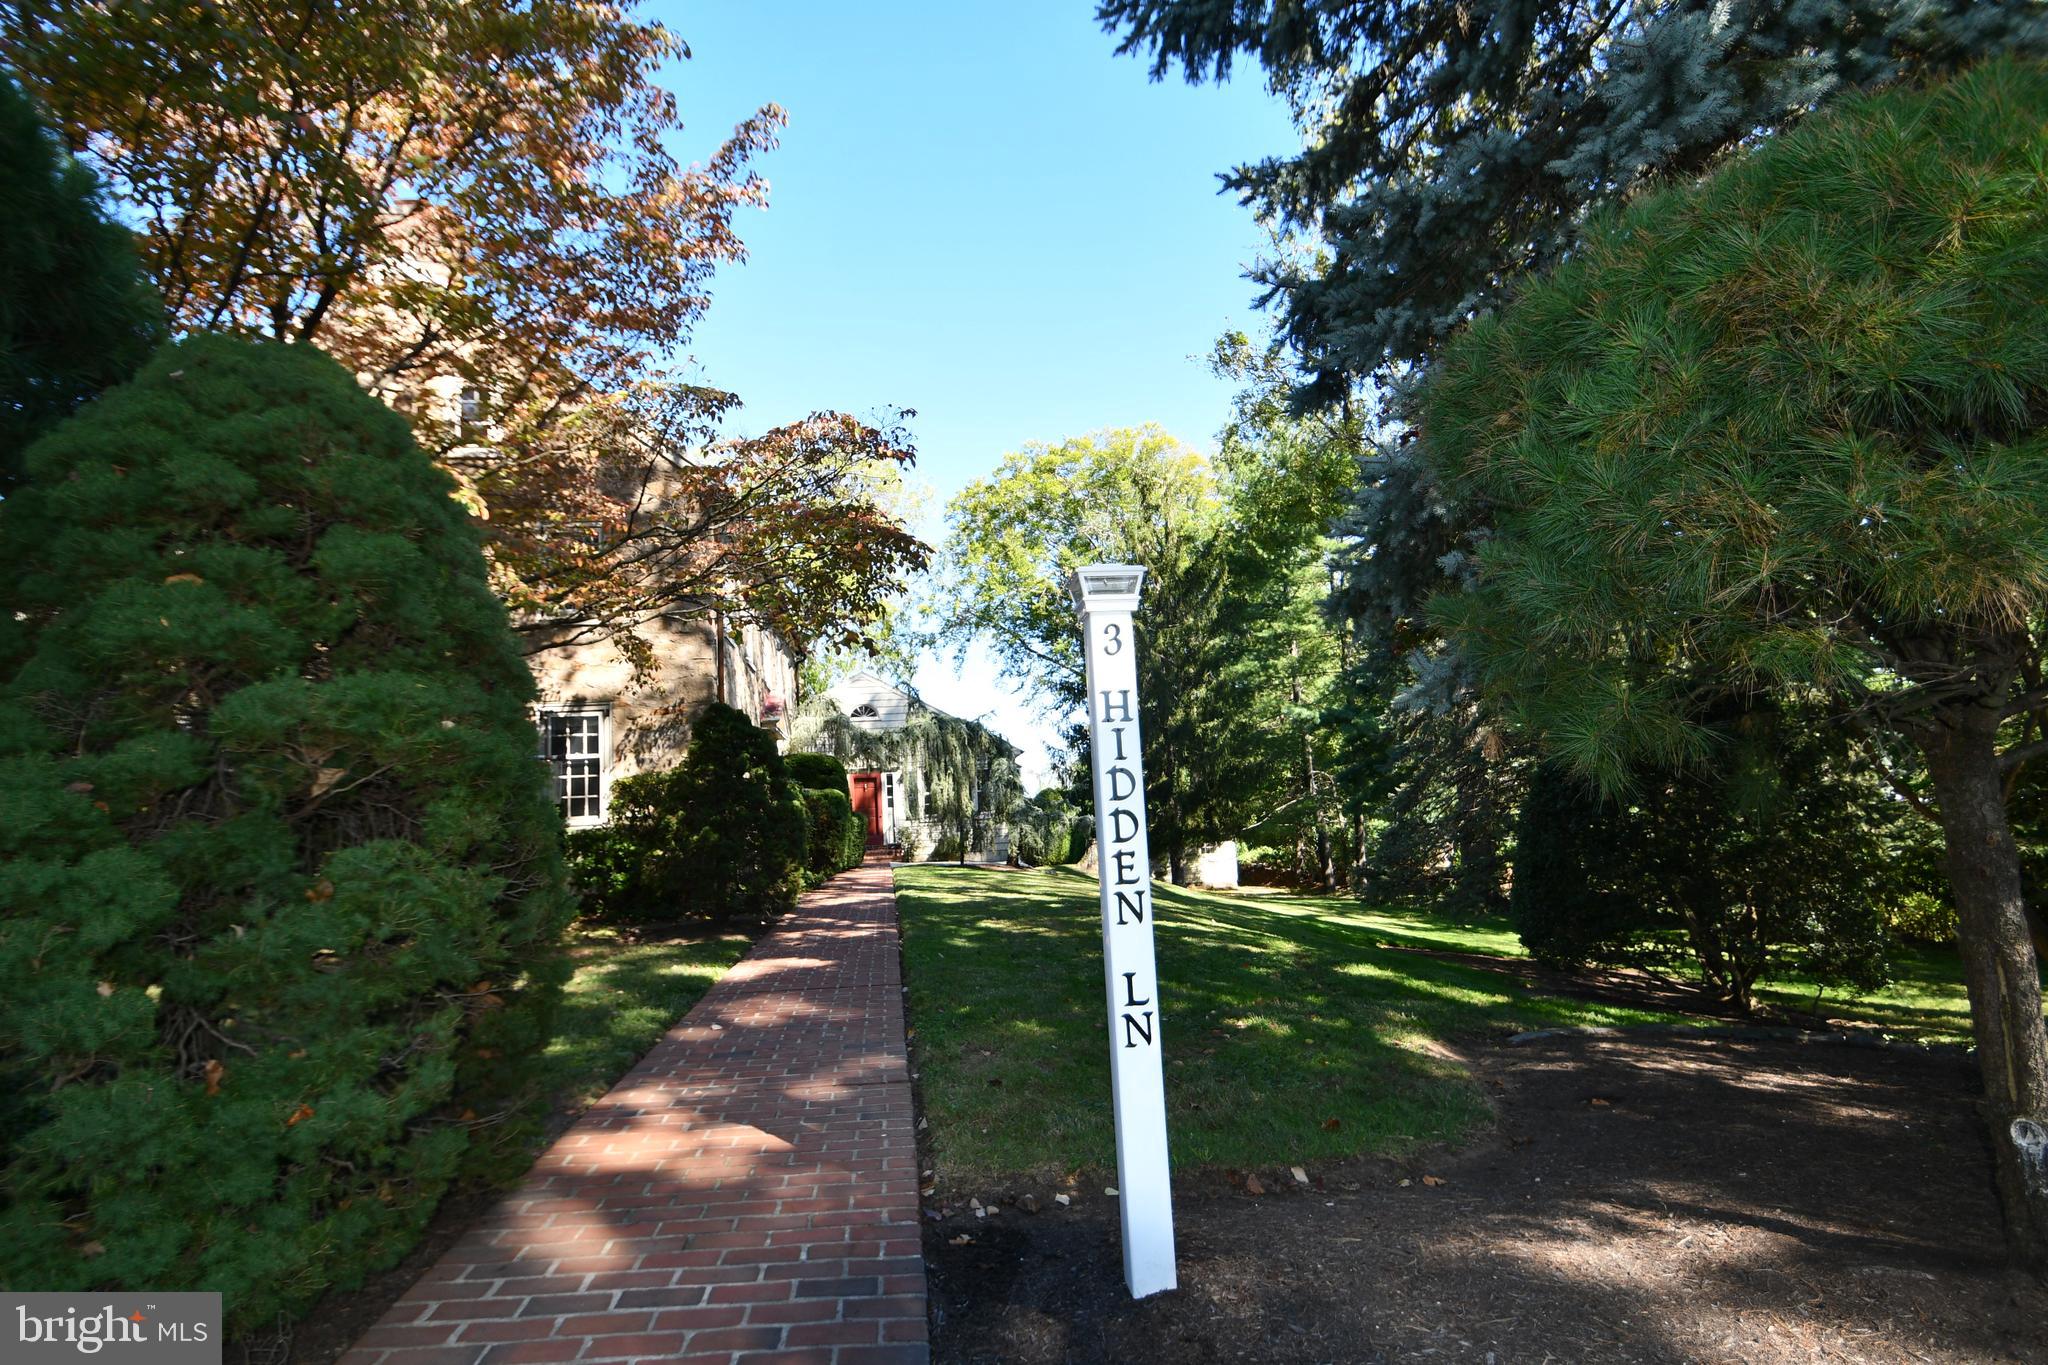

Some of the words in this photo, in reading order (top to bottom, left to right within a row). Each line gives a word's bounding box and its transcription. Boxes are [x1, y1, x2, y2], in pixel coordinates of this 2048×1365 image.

[1103, 623, 1123, 656] 3
[1099, 689, 1146, 925] HIDDEN
[1121, 971, 1154, 1049] LN
